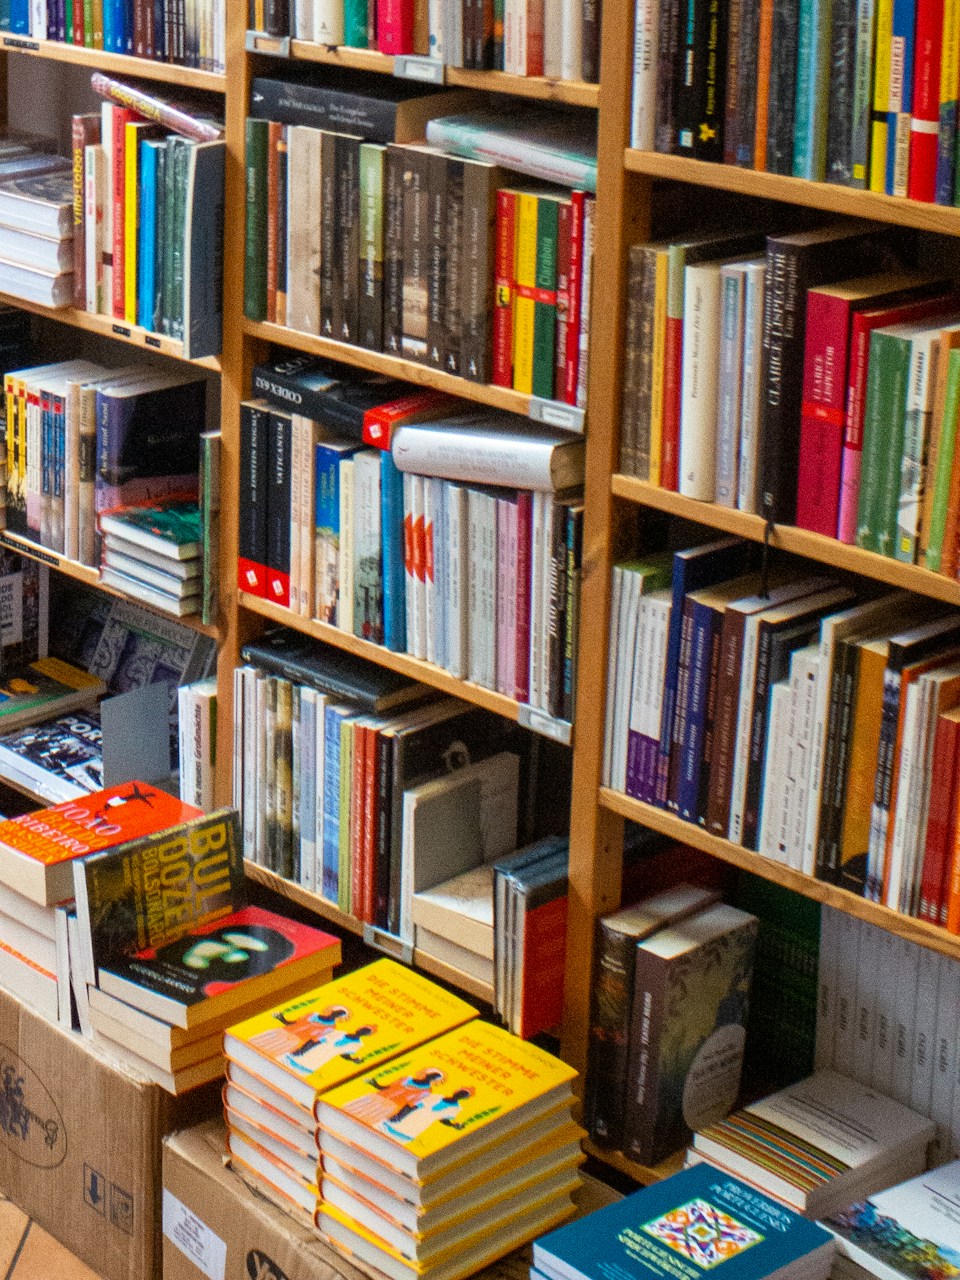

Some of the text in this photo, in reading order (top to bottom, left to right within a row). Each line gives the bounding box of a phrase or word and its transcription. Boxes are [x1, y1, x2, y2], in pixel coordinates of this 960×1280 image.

[891, 37, 904, 99] KINDHEIT
[73, 147, 84, 225] Villa-Lobos
[767, 252, 786, 407] CLARICE LISPECTOR
[275, 422, 285, 485] VATICANUM
[11, 814, 91, 854] RIBEIRO
[47, 802, 122, 837] JOÃO
[335, 985, 416, 1035] SCHWESTER
[365, 974, 443, 1020] DIE STIMME
[365, 986, 415, 1020] MEINER
[429, 1048, 515, 1098] SCHWESTER
[457, 1035, 541, 1082] DIE STIMME
[458, 1047, 512, 1080] MEINER
